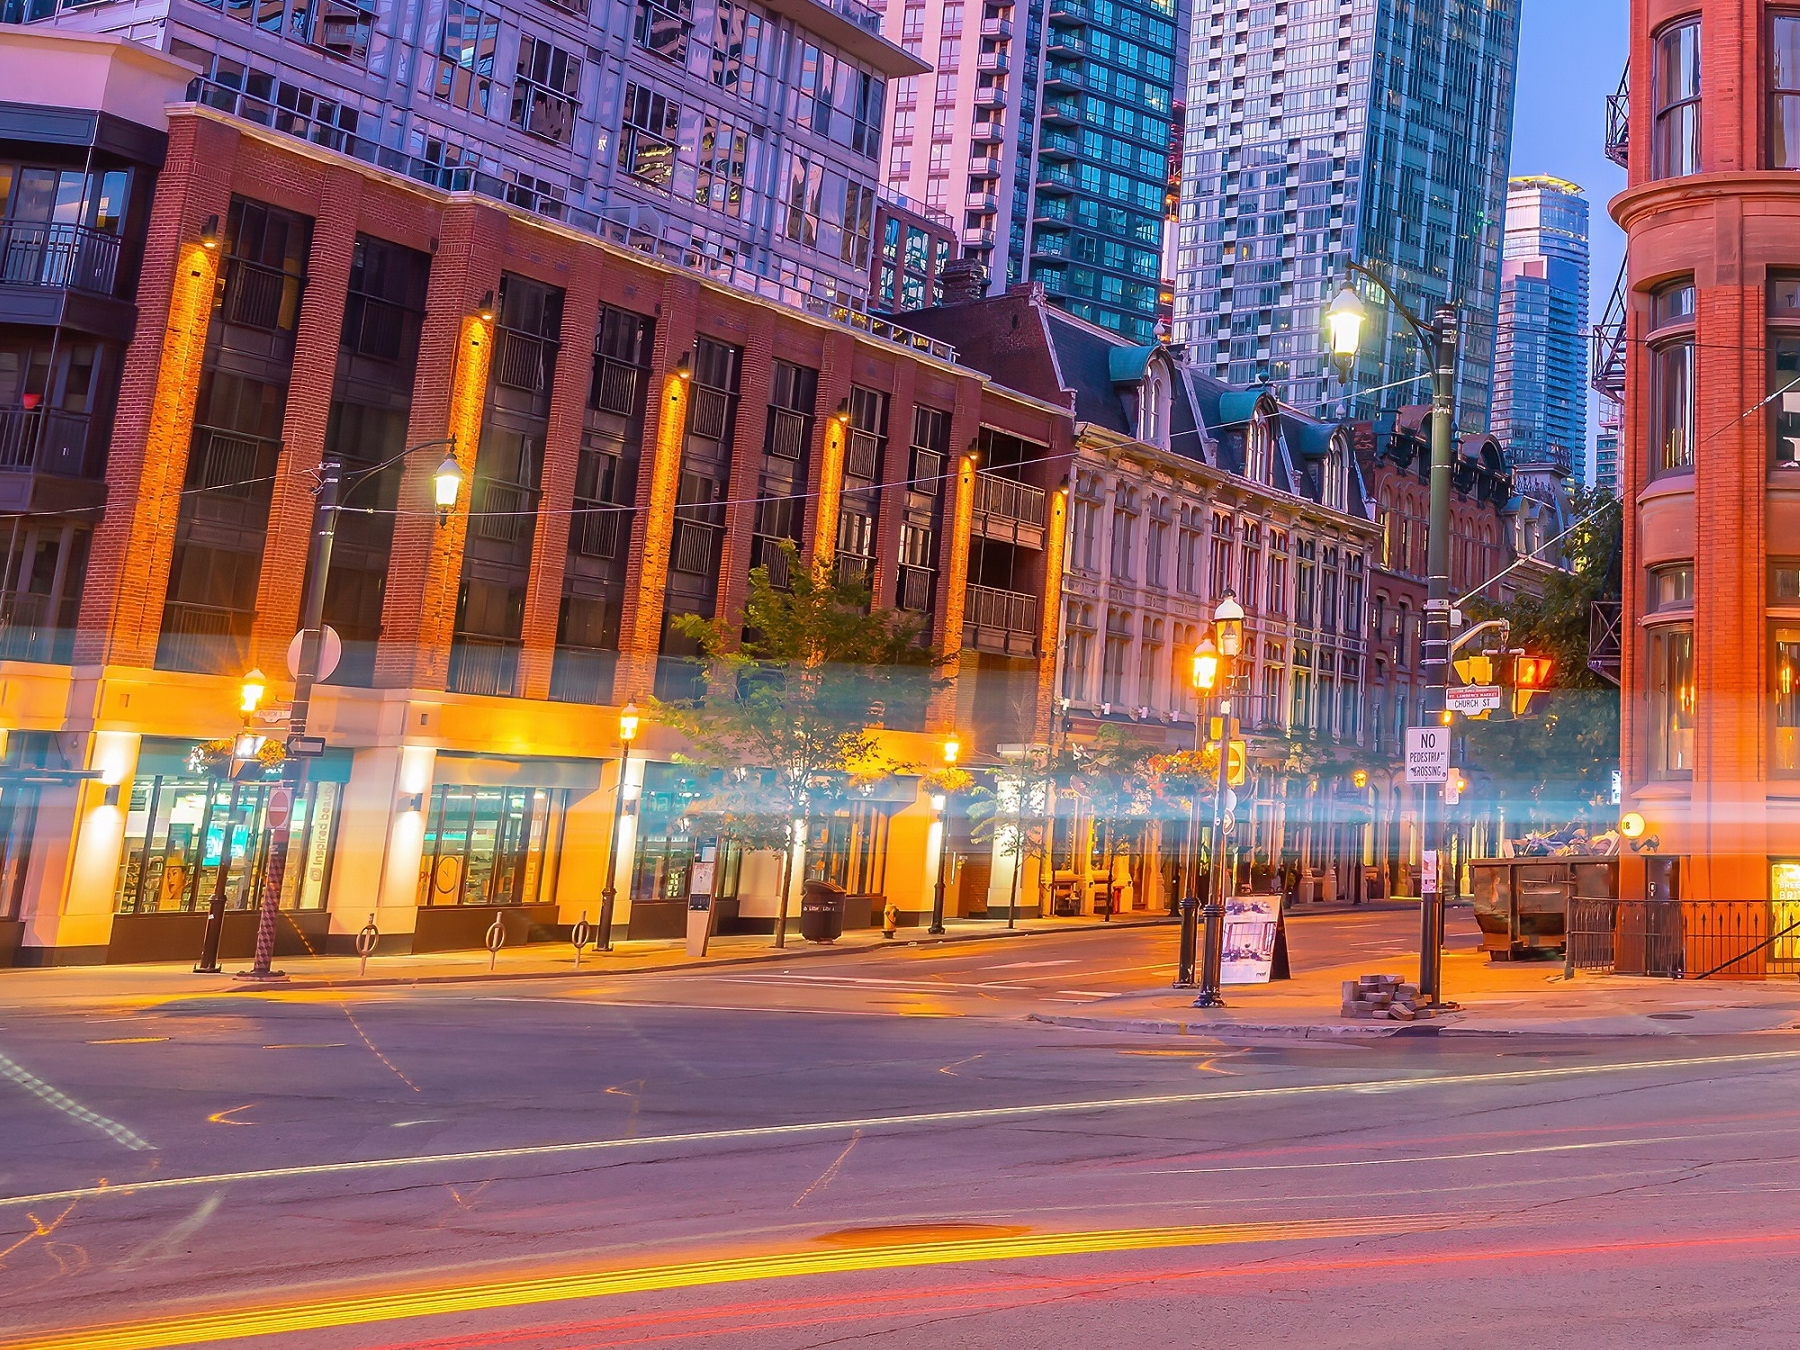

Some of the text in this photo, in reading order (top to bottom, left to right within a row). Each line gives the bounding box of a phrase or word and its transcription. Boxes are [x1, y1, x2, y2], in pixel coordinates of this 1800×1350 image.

[1454, 698, 1491, 708] CHURCH ST
[1420, 733, 1436, 748] NO
